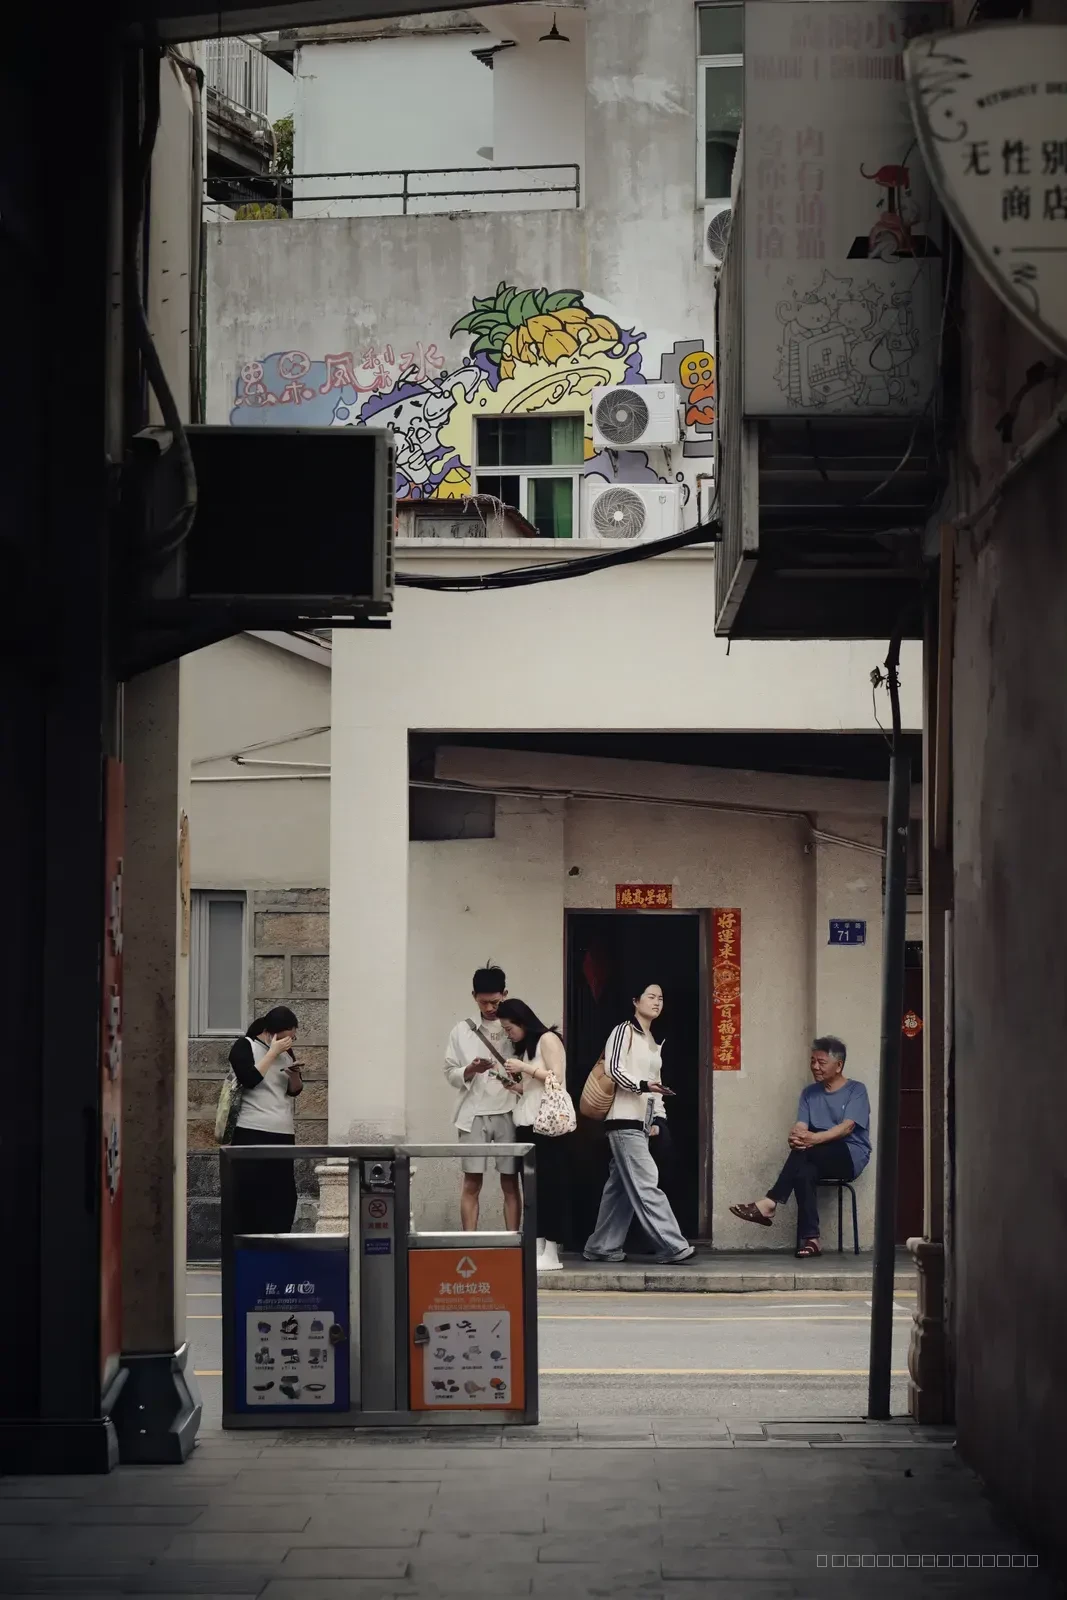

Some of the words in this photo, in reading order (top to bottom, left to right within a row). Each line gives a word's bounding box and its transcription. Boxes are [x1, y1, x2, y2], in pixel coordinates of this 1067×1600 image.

[961, 139, 1067, 176] 无性别
[1001, 184, 1067, 222] 商店
[837, 930, 849, 941] 71
[439, 1281, 491, 1295] 其他垃圾
